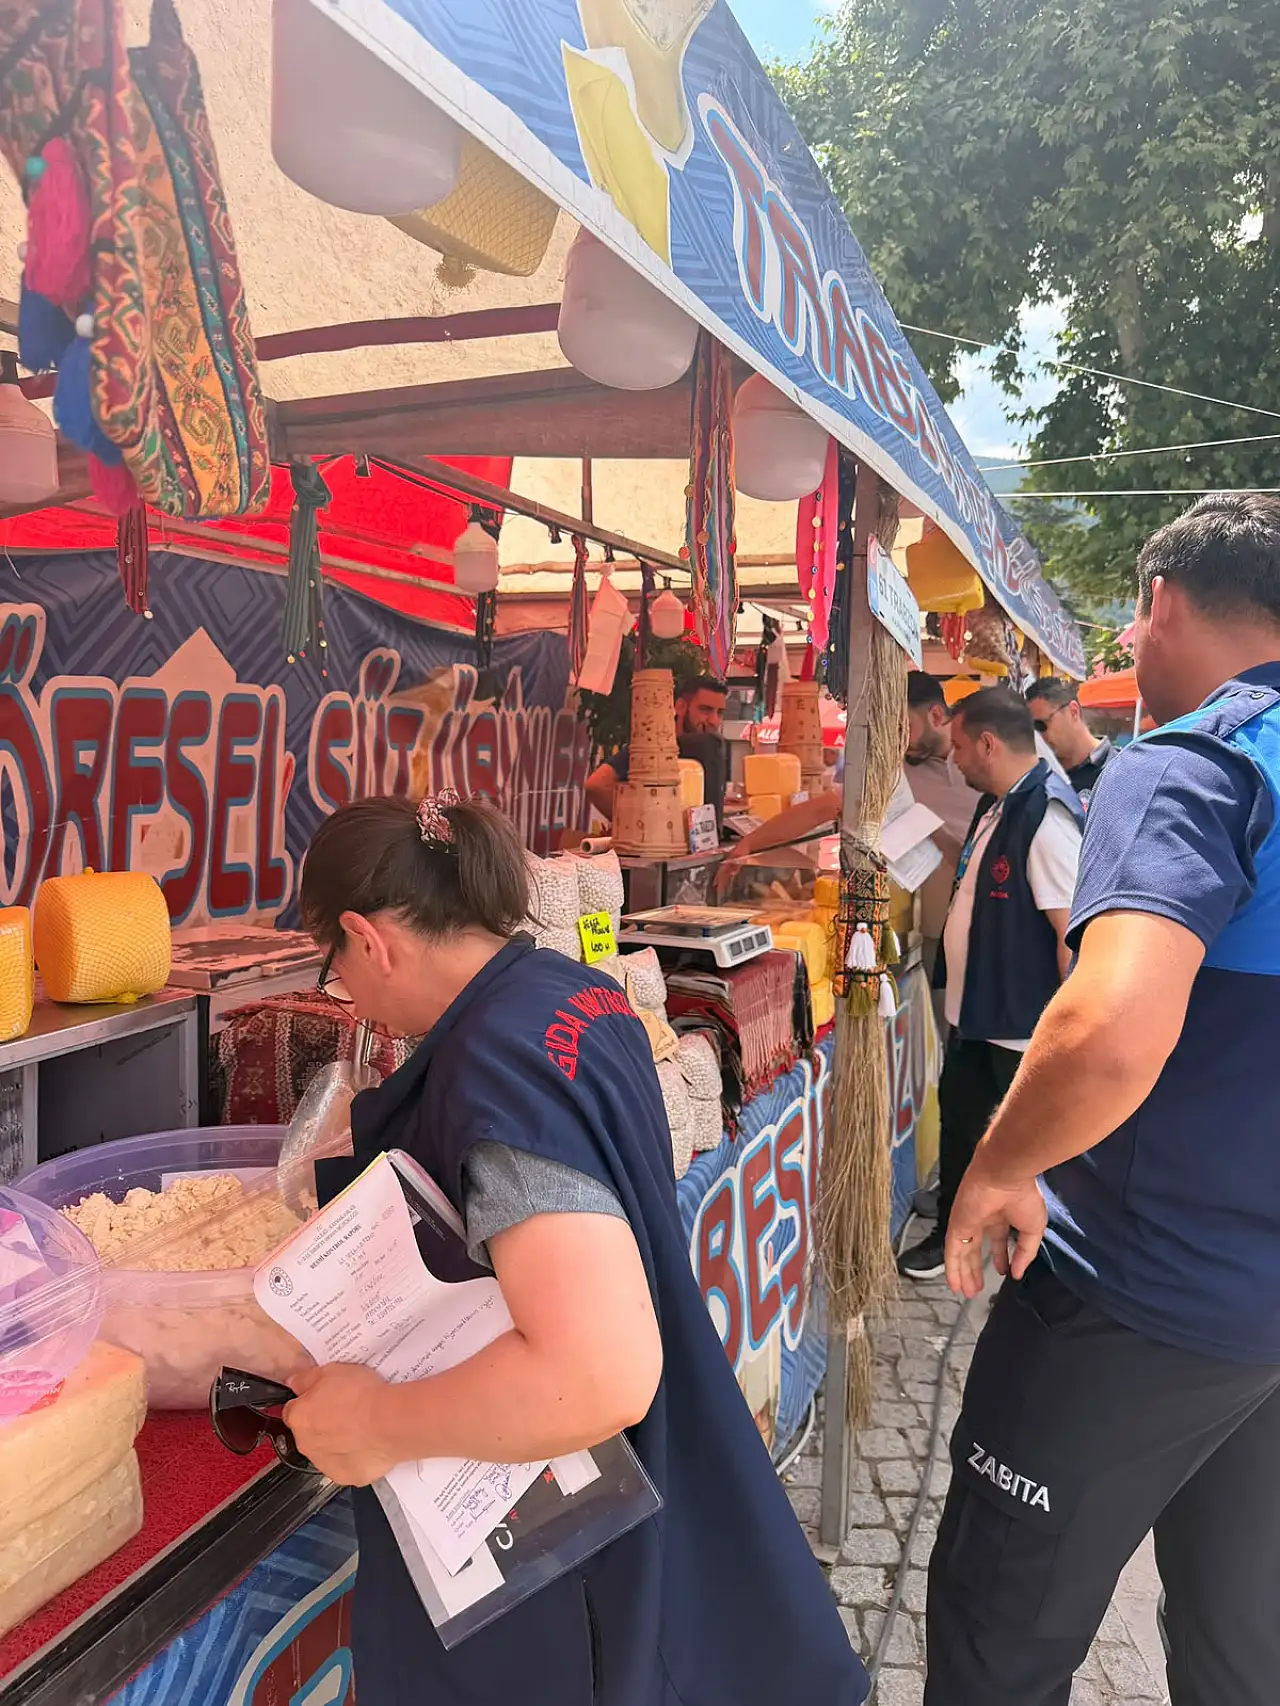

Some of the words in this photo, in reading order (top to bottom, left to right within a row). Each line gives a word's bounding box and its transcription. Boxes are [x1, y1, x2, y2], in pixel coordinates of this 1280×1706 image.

[697, 93, 966, 520] TRAB
[545, 1009, 589, 1081] GIDA
[967, 1441, 1050, 1512] ZABITA
